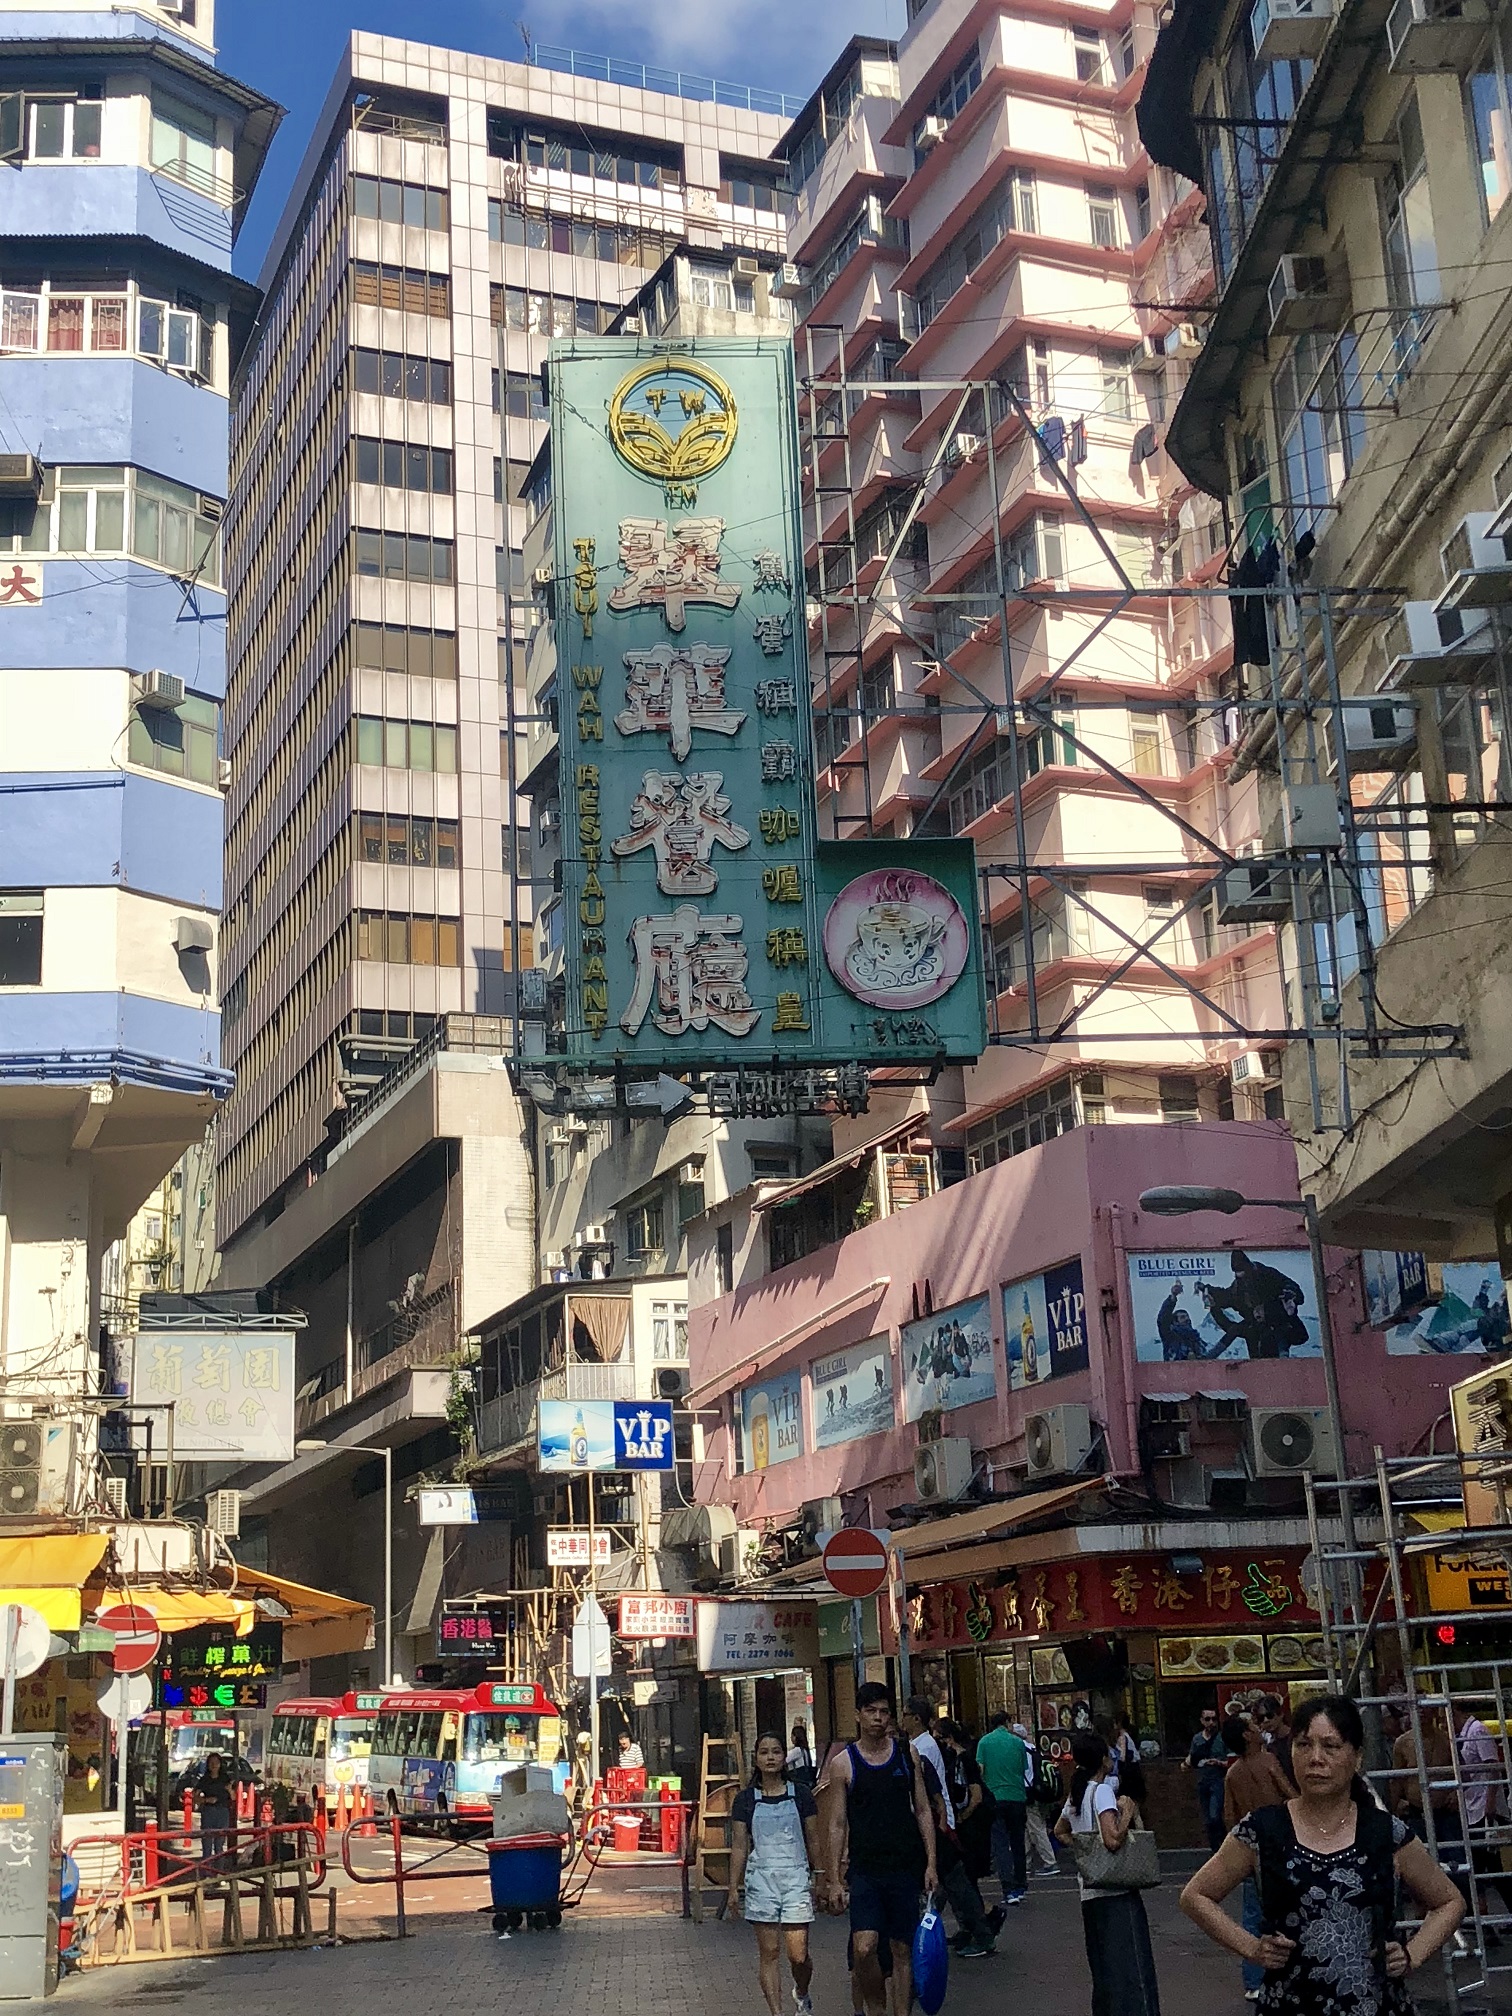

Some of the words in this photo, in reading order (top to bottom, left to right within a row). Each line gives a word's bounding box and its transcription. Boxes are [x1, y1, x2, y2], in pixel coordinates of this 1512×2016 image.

[571, 664, 604, 741] WAH
[608, 515, 761, 1036] 翠華餐廳
[576, 763, 608, 1041] RESTAURANT
[1138, 1259, 1176, 1270] BLUE
[1178, 1257, 1214, 1269] GIRL
[1402, 1262, 1422, 1290] BAR
[1048, 1290, 1085, 1330] VIP
[1056, 1326, 1083, 1352] BAR
[146, 1344, 282, 1396] 葡萄園
[616, 1416, 671, 1442] VIP
[625, 1441, 665, 1459] BAR
